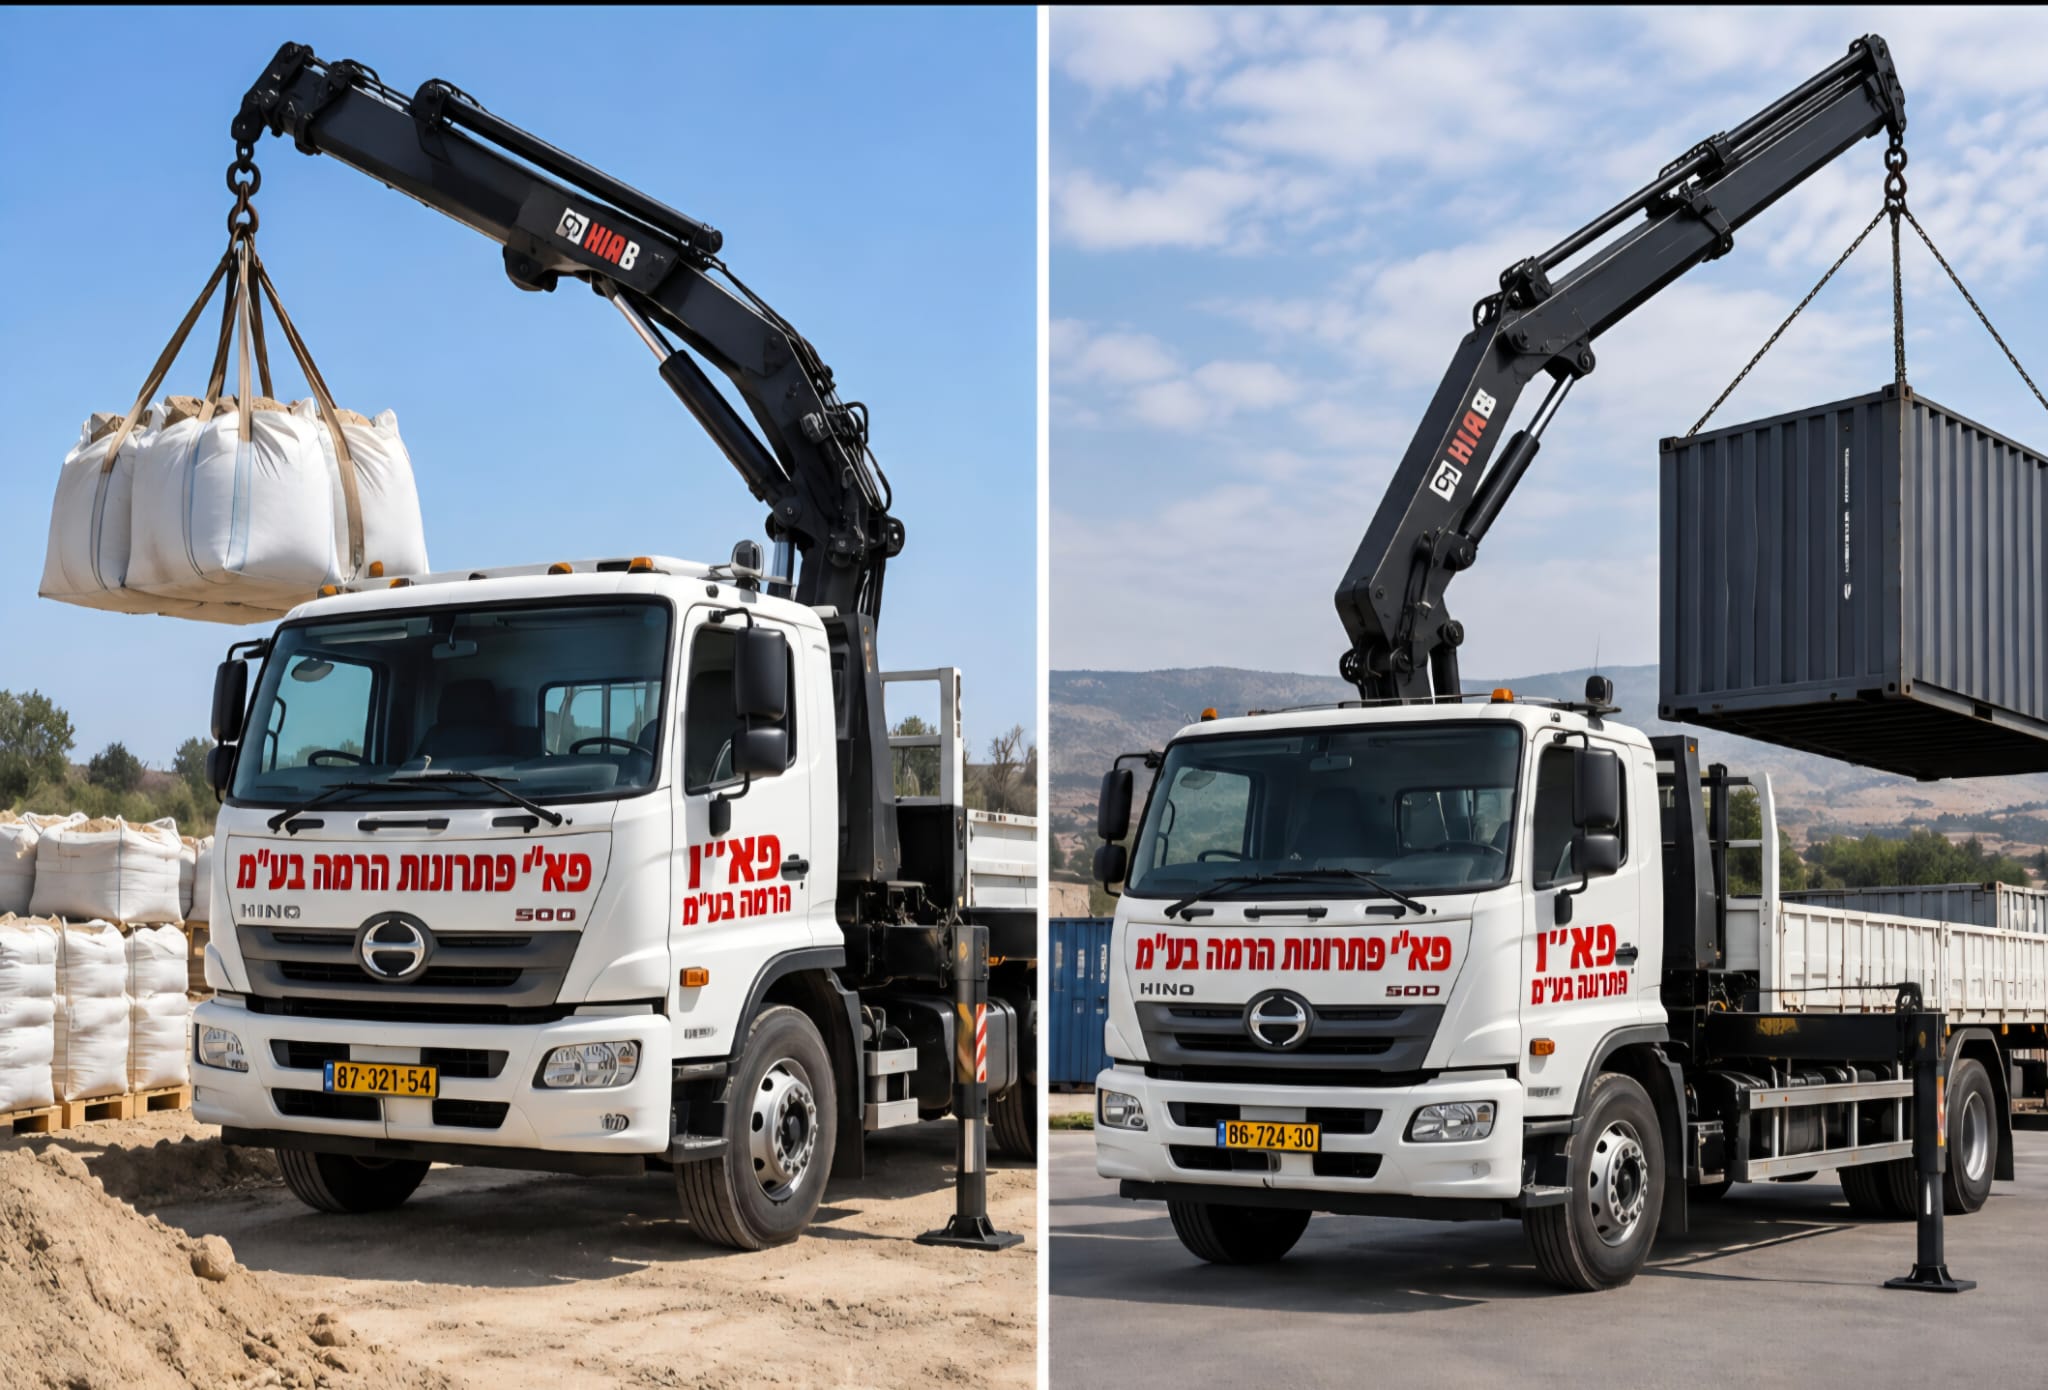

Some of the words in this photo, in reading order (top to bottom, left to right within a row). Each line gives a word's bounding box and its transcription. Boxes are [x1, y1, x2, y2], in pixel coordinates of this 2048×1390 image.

[583, 222, 640, 271] HIAB
[1447, 388, 1497, 466] HIAB
[236, 848, 305, 890] בע"מ
[313, 854, 389, 891] הרמה
[396, 855, 516, 892] פתרונות
[515, 908, 576, 922] 500
[682, 892, 735, 926] בע"מ
[740, 885, 791, 918] הרמה
[1135, 932, 1199, 970] בע"מ
[1206, 938, 1275, 971] הרמה
[1281, 937, 1386, 971] פתרונות
[1141, 983, 1194, 996] HINO
